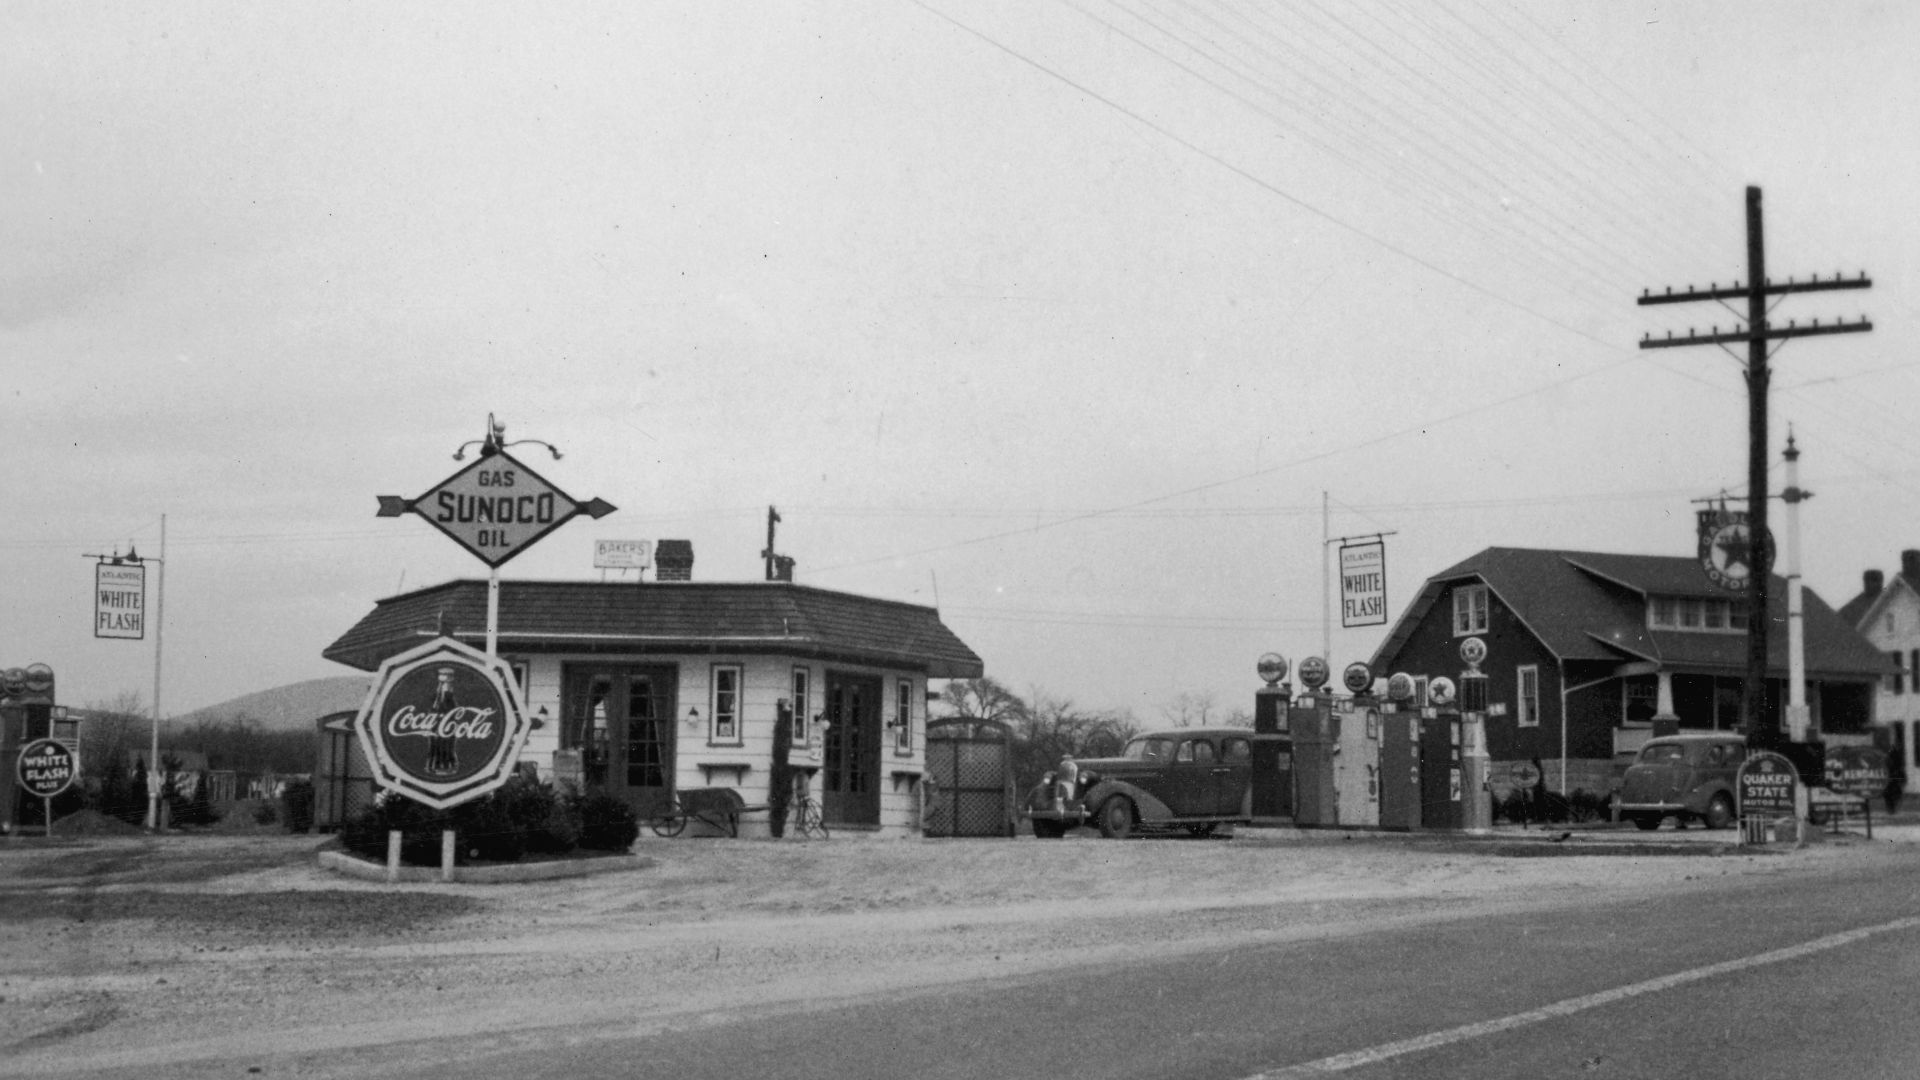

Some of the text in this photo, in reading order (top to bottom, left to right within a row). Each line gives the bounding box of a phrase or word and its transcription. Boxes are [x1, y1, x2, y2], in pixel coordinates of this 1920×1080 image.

[478, 470, 515, 487] GAS
[437, 490, 554, 523] SUNOCO
[478, 530, 510, 547] OIL
[1344, 572, 1381, 593] WHITE
[100, 590, 141, 609] WHITE
[1345, 596, 1382, 618] FLASH
[99, 612, 140, 631] FLASH
[388, 704, 497, 739] Coca-Cola
[24, 754, 68, 767] WHITE
[26, 767, 69, 781] FLASH
[1743, 774, 1792, 786] QUAKER
[36, 781, 58, 789] PLUS
[1747, 787, 1788, 798] STATE
[1779, 799, 1793, 807] OIL
